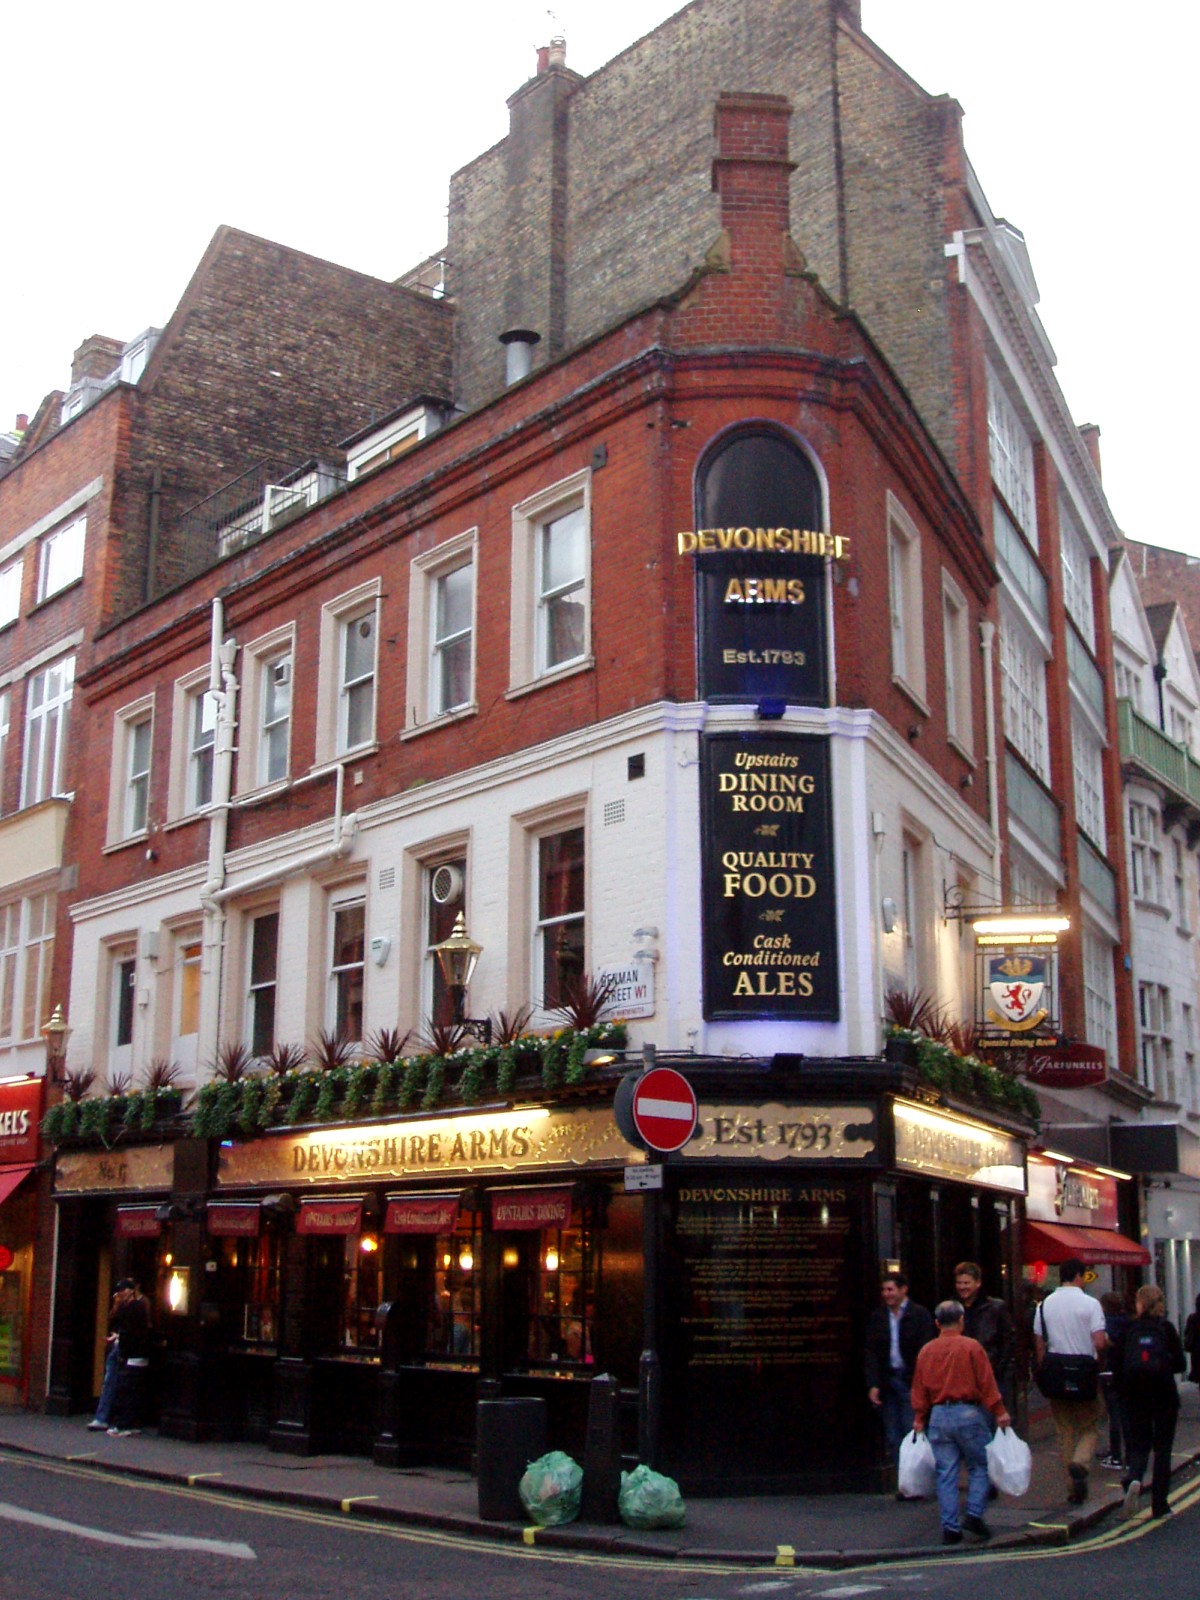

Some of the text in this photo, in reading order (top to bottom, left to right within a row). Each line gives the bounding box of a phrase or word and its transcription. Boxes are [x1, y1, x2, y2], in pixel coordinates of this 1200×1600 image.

[678, 527, 851, 559] DEVONSHIRE
[723, 578, 806, 604] ARMS
[735, 753, 799, 770] Upstairs
[719, 773, 816, 794] DINING
[732, 795, 804, 813] ROOM
[722, 852, 815, 872] QUALITY
[723, 873, 817, 898] FOOD
[753, 933, 792, 949] Cask
[723, 950, 820, 967] Conditioned
[635, 985, 647, 999] W1
[732, 971, 814, 997] ALES
[714, 1118, 832, 1150] Est 1793
[292, 1126, 530, 1173] DEVONSHIRE ARMS
[678, 1188, 847, 1202] DEVONSHIRE ARMS
[496, 1203, 566, 1221] UPSTAIRS DINING
